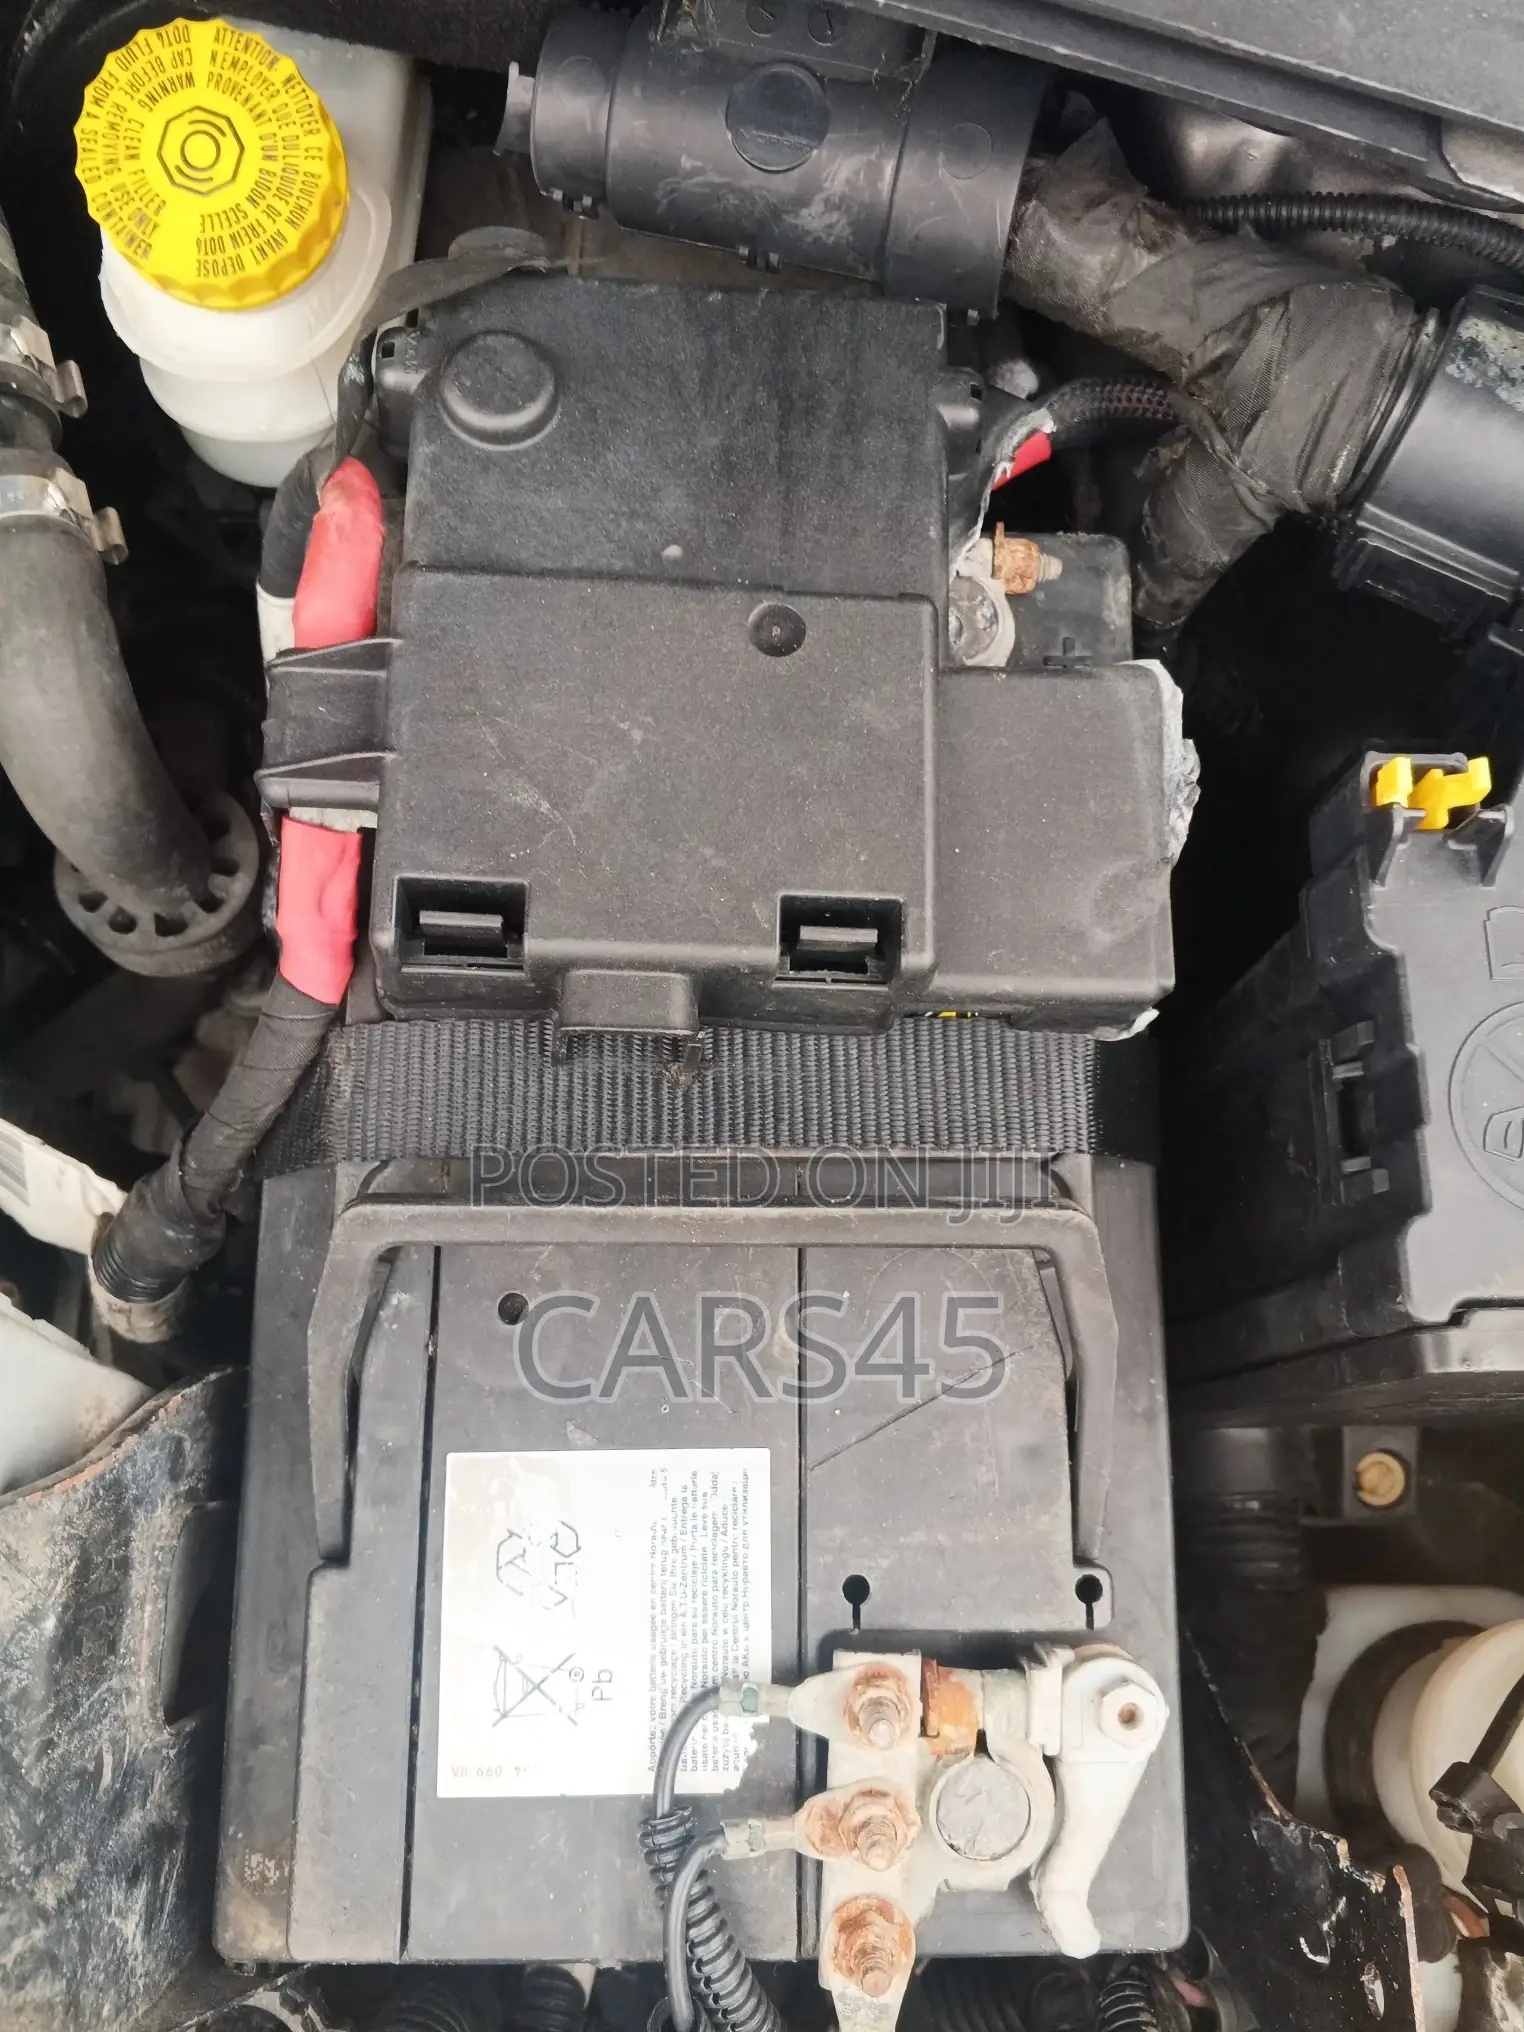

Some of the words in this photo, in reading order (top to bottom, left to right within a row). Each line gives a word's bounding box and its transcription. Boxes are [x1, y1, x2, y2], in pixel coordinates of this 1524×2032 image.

[115, 37, 154, 72] FLUID
[171, 47, 193, 70] CAP
[90, 69, 120, 109] FROM
[118, 56, 167, 100] BEFORE
[138, 71, 196, 113] WARNING
[208, 71, 272, 127] PROVENANT
[272, 103, 297, 130] QUE
[281, 73, 321, 137] NETTOYER
[80, 127, 101, 184] SEALED
[123, 118, 145, 160] CLEAN
[304, 147, 323, 161] CE
[110, 182, 135, 211] USE
[127, 168, 167, 217] FILLER
[245, 168, 277, 209] BIDON
[272, 154, 300, 207] LIQUIDE
[284, 171, 322, 230] BOUCHON
[92, 192, 153, 260] CONTAINER
[128, 207, 160, 240] ONLY
[200, 203, 249, 233] SCELLE
[229, 218, 268, 250] FREIN
[261, 203, 282, 225] DE
[196, 253, 245, 278] DEPOSE
[250, 229, 288, 266] AVANT
[670, 1497, 679, 1554] gebauchte
[591, 1668, 614, 1702] Pb
